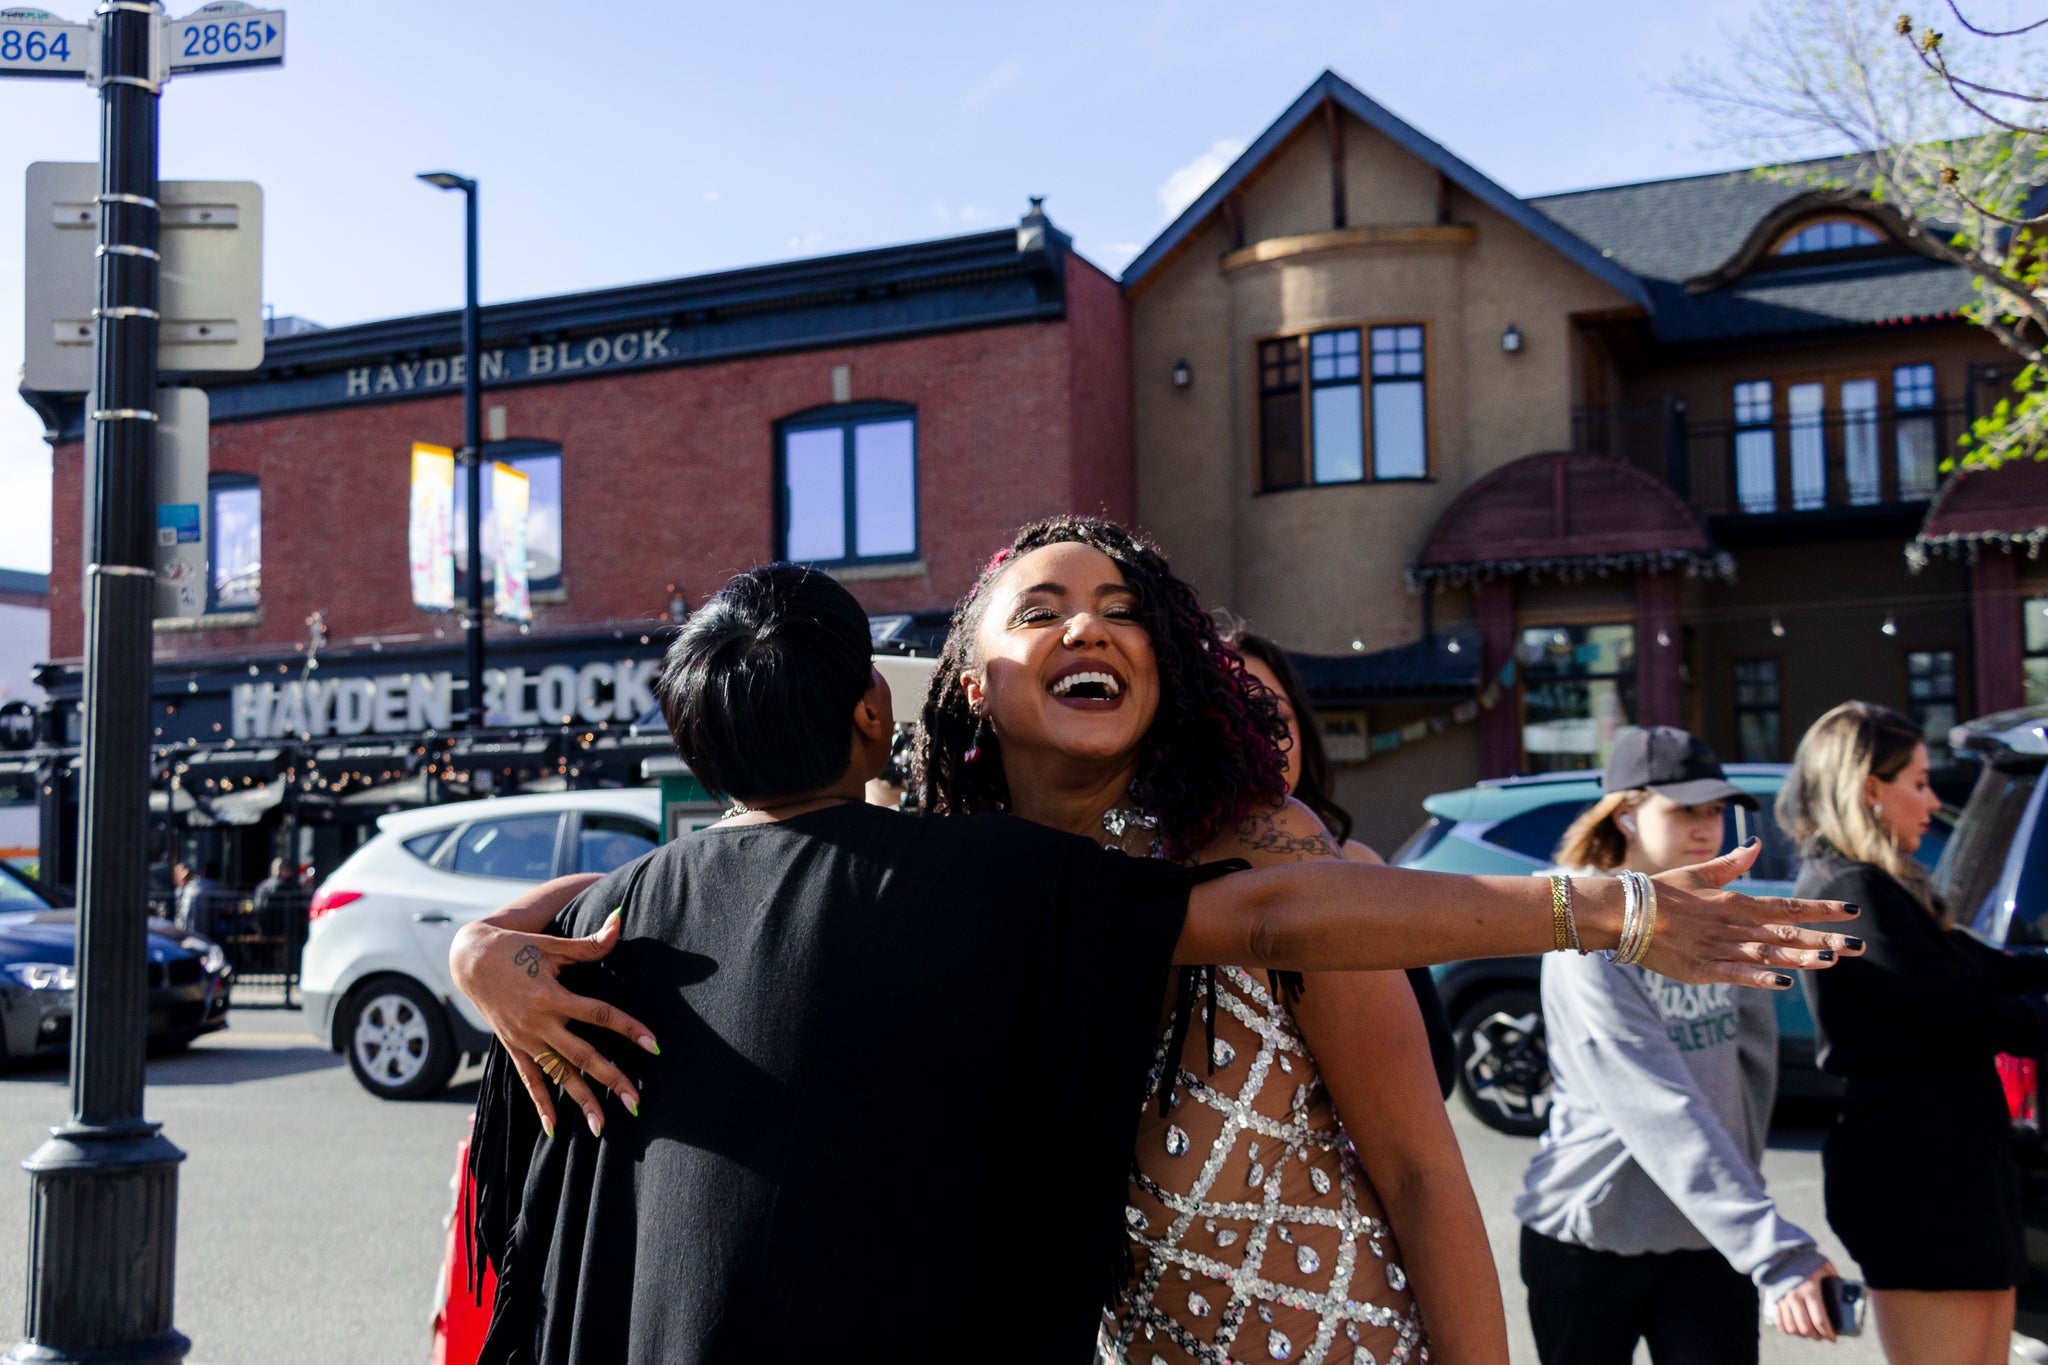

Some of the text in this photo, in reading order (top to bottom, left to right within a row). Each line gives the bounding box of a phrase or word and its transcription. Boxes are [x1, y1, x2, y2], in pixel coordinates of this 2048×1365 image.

[1, 30, 71, 62] 864
[184, 20, 262, 56] 2865
[232, 671, 452, 740] HAYDEN
